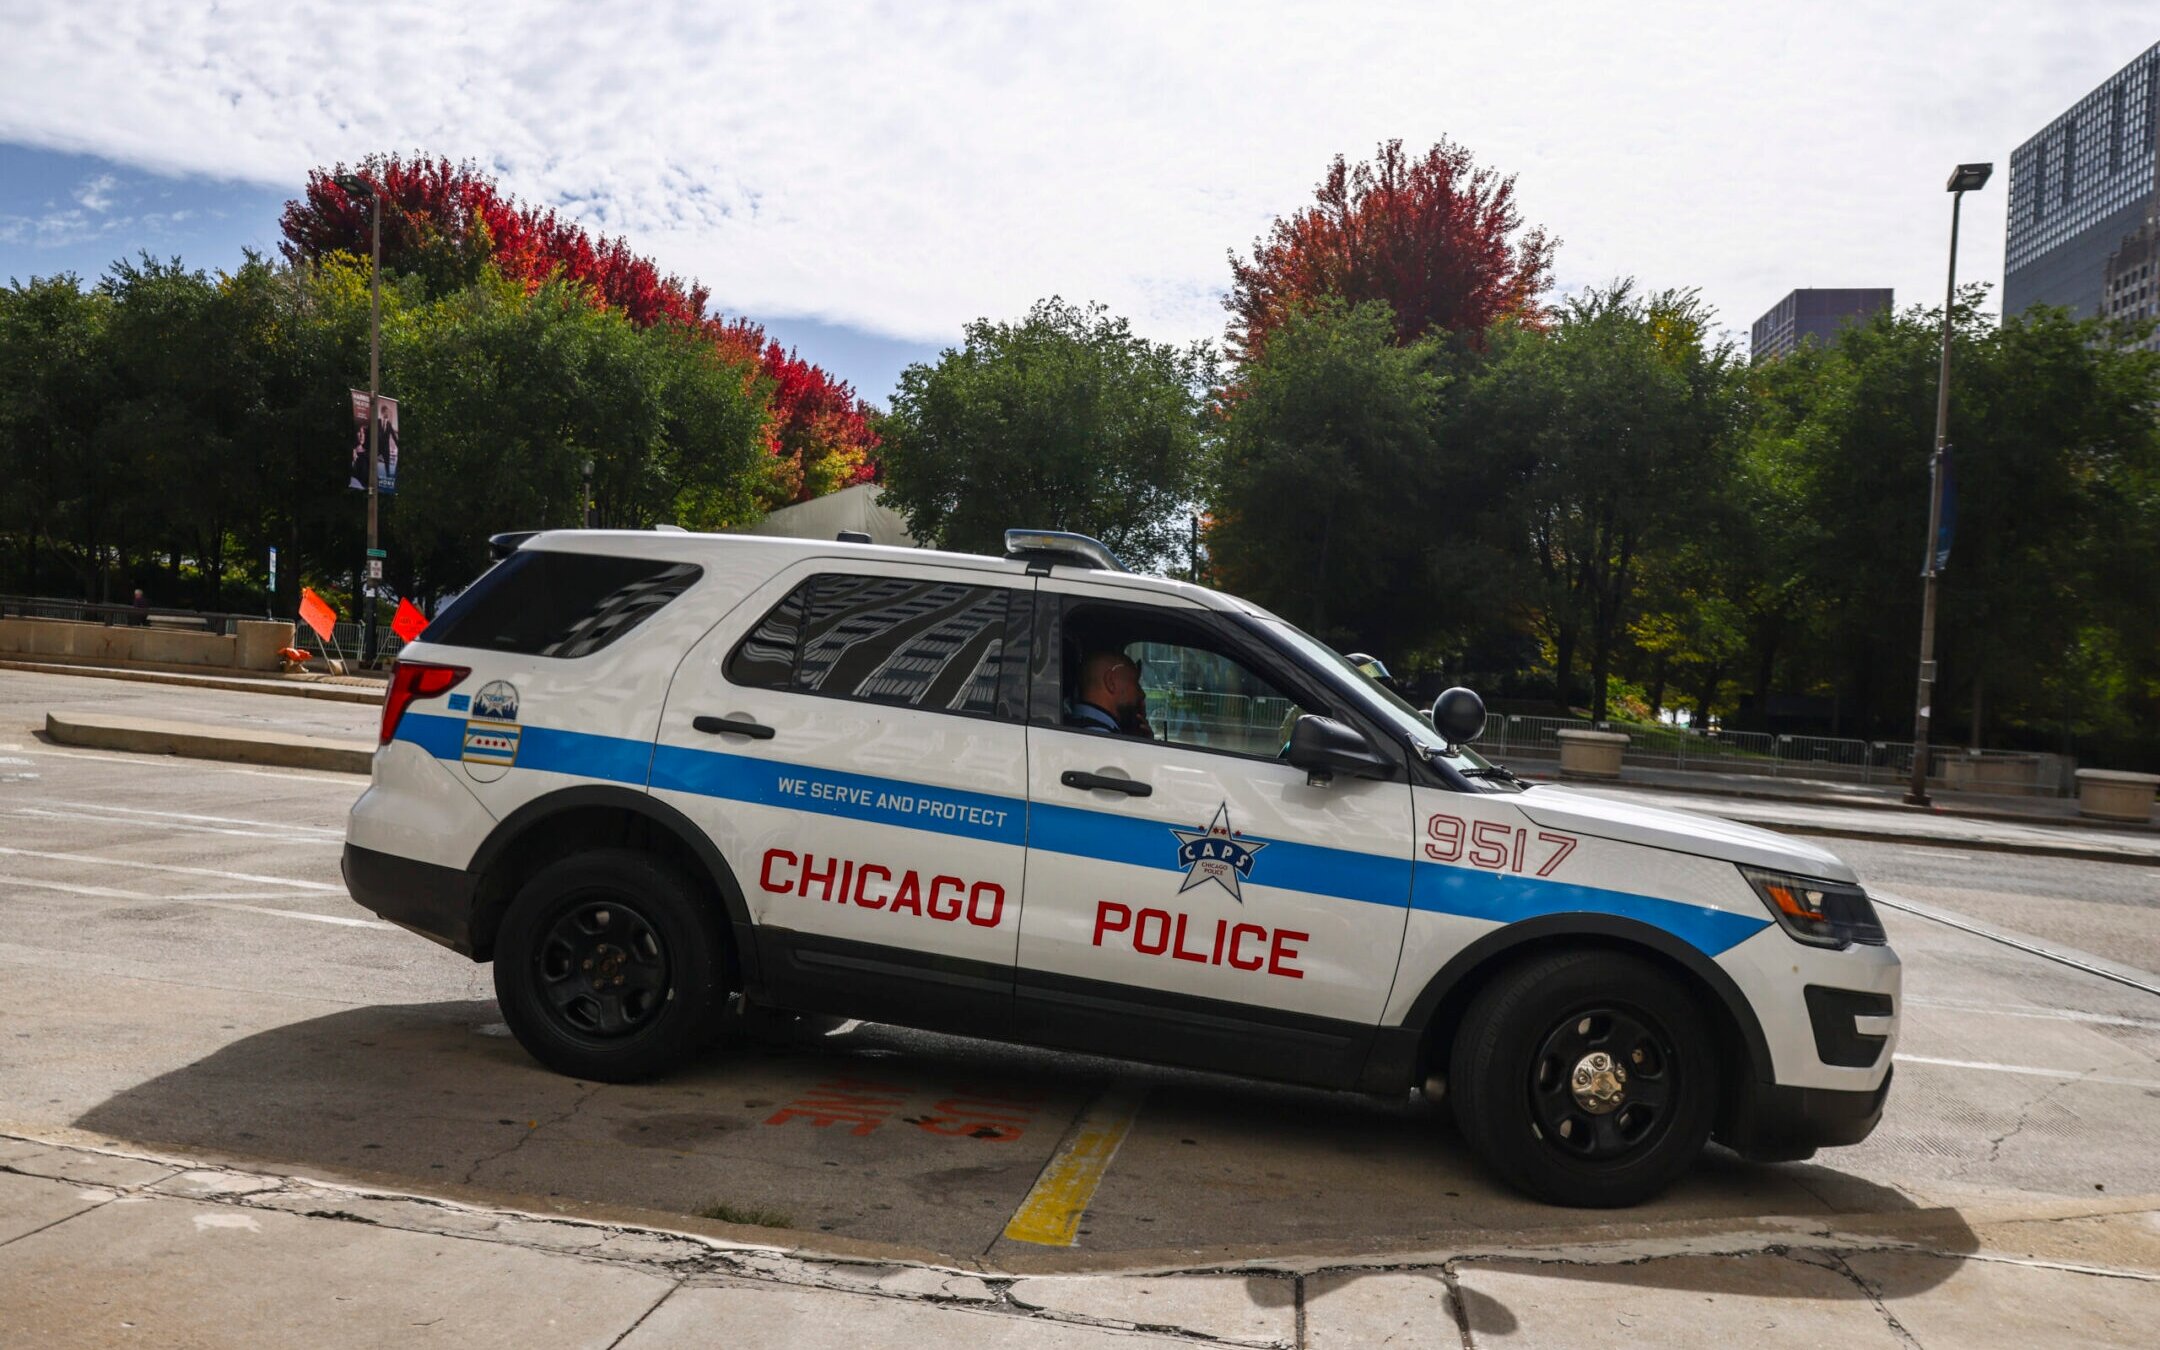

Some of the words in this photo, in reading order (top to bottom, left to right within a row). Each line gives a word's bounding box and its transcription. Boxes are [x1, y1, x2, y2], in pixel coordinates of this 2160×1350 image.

[778, 776, 807, 796] WE
[811, 782, 873, 806] SERVE
[876, 792, 915, 813] AND
[917, 799, 1008, 828] PROTECT
[1185, 842, 1249, 868] CAPS
[1201, 861, 1228, 871] CHICAGO
[1204, 868, 1224, 876] POLICE
[1425, 813, 1578, 877] 9517
[760, 848, 1006, 928] CHICAGO
[1092, 900, 1310, 979] POLICE
[763, 1066, 914, 1137] ANE
